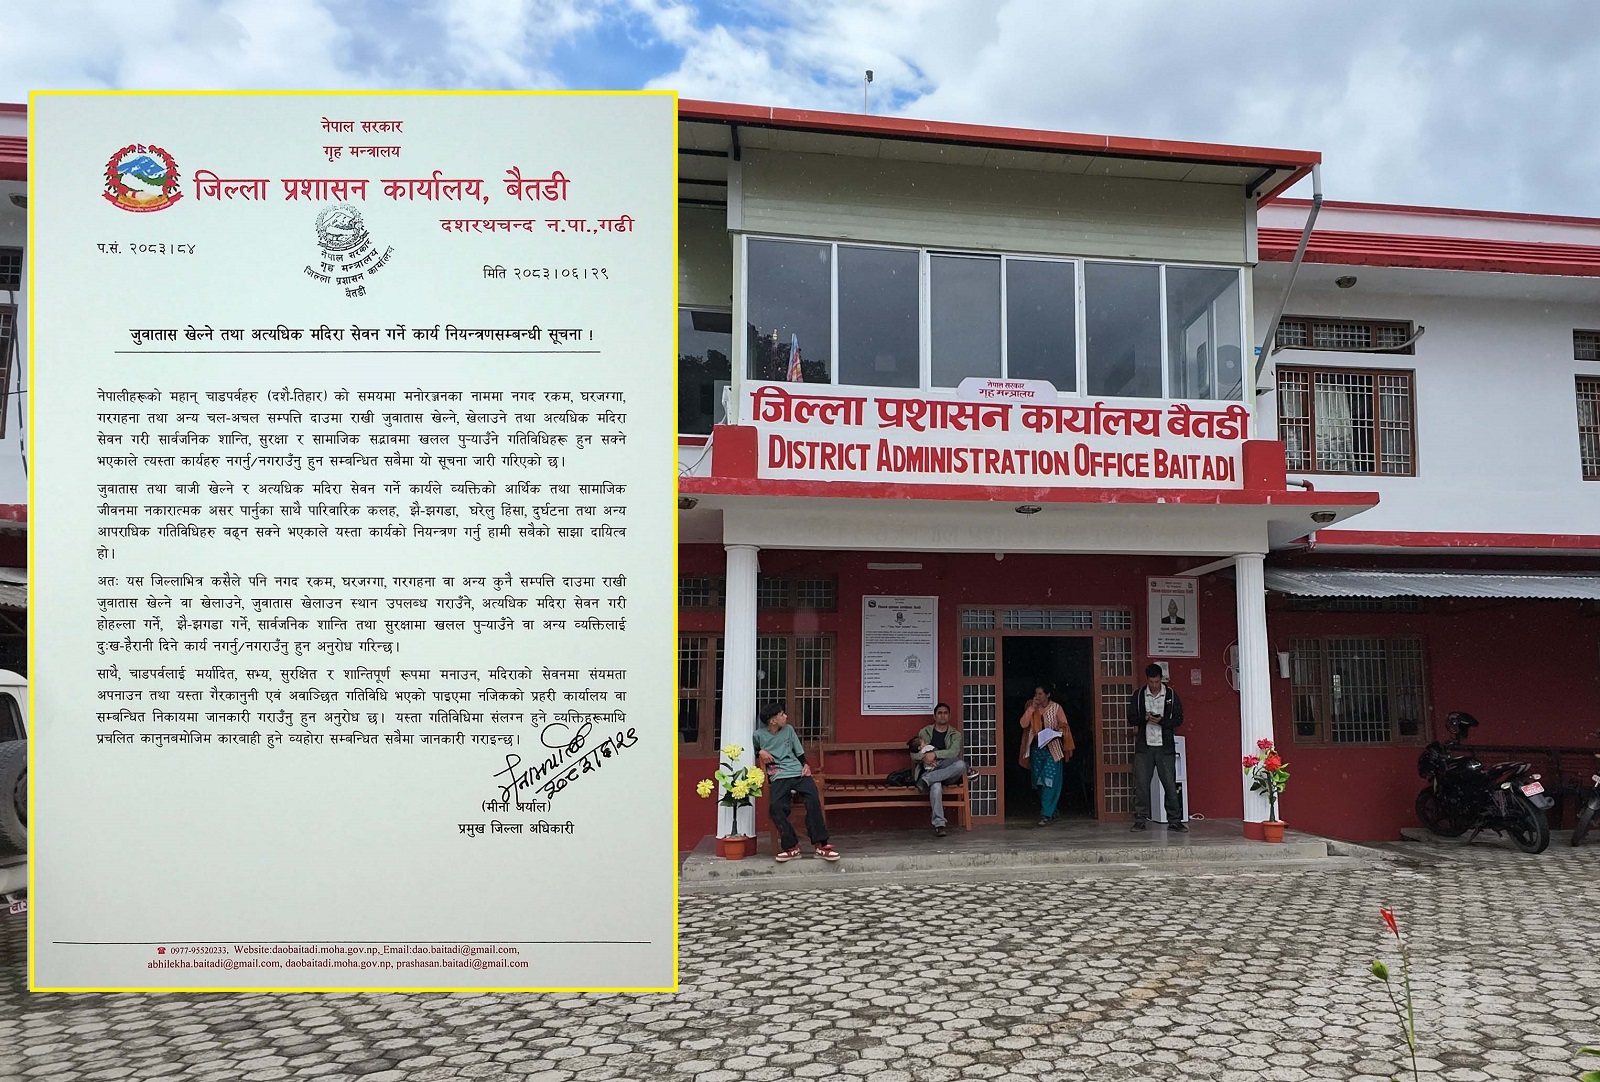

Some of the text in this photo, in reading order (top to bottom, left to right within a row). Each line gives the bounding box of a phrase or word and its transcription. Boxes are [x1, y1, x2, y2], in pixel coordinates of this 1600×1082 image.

[321, 117, 403, 133] नेपाल सरकार
[323, 146, 401, 162] गृह मन्त्रालय
[193, 166, 571, 205] जिल्ला प्रशासन कार्यालय, बैतडी
[439, 215, 635, 234] दशरथचन्द न.पा.,गढी
[97, 241, 195, 255] प.सं. २०८३।८४
[483, 265, 507, 279] मिति
[129, 329, 178, 345] जुवातास
[183, 325, 214, 341] खेल्ने
[219, 329, 245, 341] तथा
[252, 324, 304, 340] अत्यधिक
[309, 324, 345, 341] मदिरा
[350, 325, 381, 341] सेवन
[385, 324, 407, 340] गर्ने
[412, 324, 440, 340] कार्य
[445, 324, 542, 341] नियन्त्रणसम्बन्धी
[547, 329, 583, 345] सूचना
[169, 392, 199, 405] महान्
[333, 388, 350, 401] को
[357, 392, 396, 402] समयमा
[470, 392, 503, 401] नाममा
[511, 392, 536, 402] नगद
[543, 392, 573, 404] रकम,
[580, 392, 626, 404] घरजग्गा,
[97, 409, 627, 427] गरगहना तथा अन्य चल-अचल सम्पत्ति दाउमा राखी जुवातास खेल्ने, खेलाउने तथा अत्यधिक मदिरा
[750, 386, 1250, 440] जिल्ला प्रशासन कार्यालय बैतडी
[97, 453, 138, 468] भएकाले
[143, 457, 175, 467] त्यस्ता
[307, 457, 324, 471] हुन
[329, 452, 379, 466] सम्बन्धित
[419, 452, 432, 466] यो
[437, 457, 468, 470] सूचना
[472, 453, 496, 467] जारी
[501, 452, 542, 468] गरिएको
[768, 434, 1236, 482] DISTRICT ADMINISTRATION OFFICE BAITADI
[126, 577, 144, 587] यस
[150, 573, 204, 586] जिल्लाभित्र
[210, 571, 242, 587] कसैले
[248, 573, 268, 587] पनि
[274, 577, 300, 587] नगद
[306, 577, 335, 589] रकम,
[341, 577, 387, 589] घरजग्गा,
[392, 577, 436, 588] गरगहना
[442, 577, 455, 587] वा
[463, 577, 486, 587] अन्य
[492, 571, 513, 591] कुनै
[519, 573, 556, 587] सम्पत्ति
[562, 577, 595, 587] दाउमा
[602, 574, 627, 587] राखी
[158, 637, 179, 651] दिने
[183, 638, 208, 651] कार्य
[294, 642, 311, 656] हुन
[317, 638, 353, 655] अनुरोध
[96, 664, 627, 683] साथै, चाडपर्वलाई मर्यादित, सभ्य, सुरक्षित र शान्तिपूर्ण रूपमा मनाउन, मदिराको सेवनमा संयमता
[97, 691, 143, 700] अपनाउन
[149, 691, 170, 700] तथा
[176, 691, 203, 701] यस्ता
[209, 685, 259, 705] गैरकानुनी
[265, 688, 282, 703] एवं
[345, 688, 388, 701] गतिविधि
[395, 688, 426, 703] भएको
[477, 688, 525, 701] नजिकको
[530, 688, 557, 702] प्रहरी
[562, 688, 608, 701] कार्यालय
[614, 692, 627, 701] वा
[96, 730, 135, 744] प्रचलित
[217, 731, 262, 745] कारवाही
[266, 730, 283, 749] हुने
[329, 731, 379, 744] सम्बन्धित
[419, 731, 465, 745] जानकारी
[458, 820, 575, 838] प्रमुख जिल्ला अधिकारी
[148, 959, 528, 970] abhilekha.baitadi@gmail.com, daobaitadi.moha.gov.np, prashasan.baitadi@gmail.com
